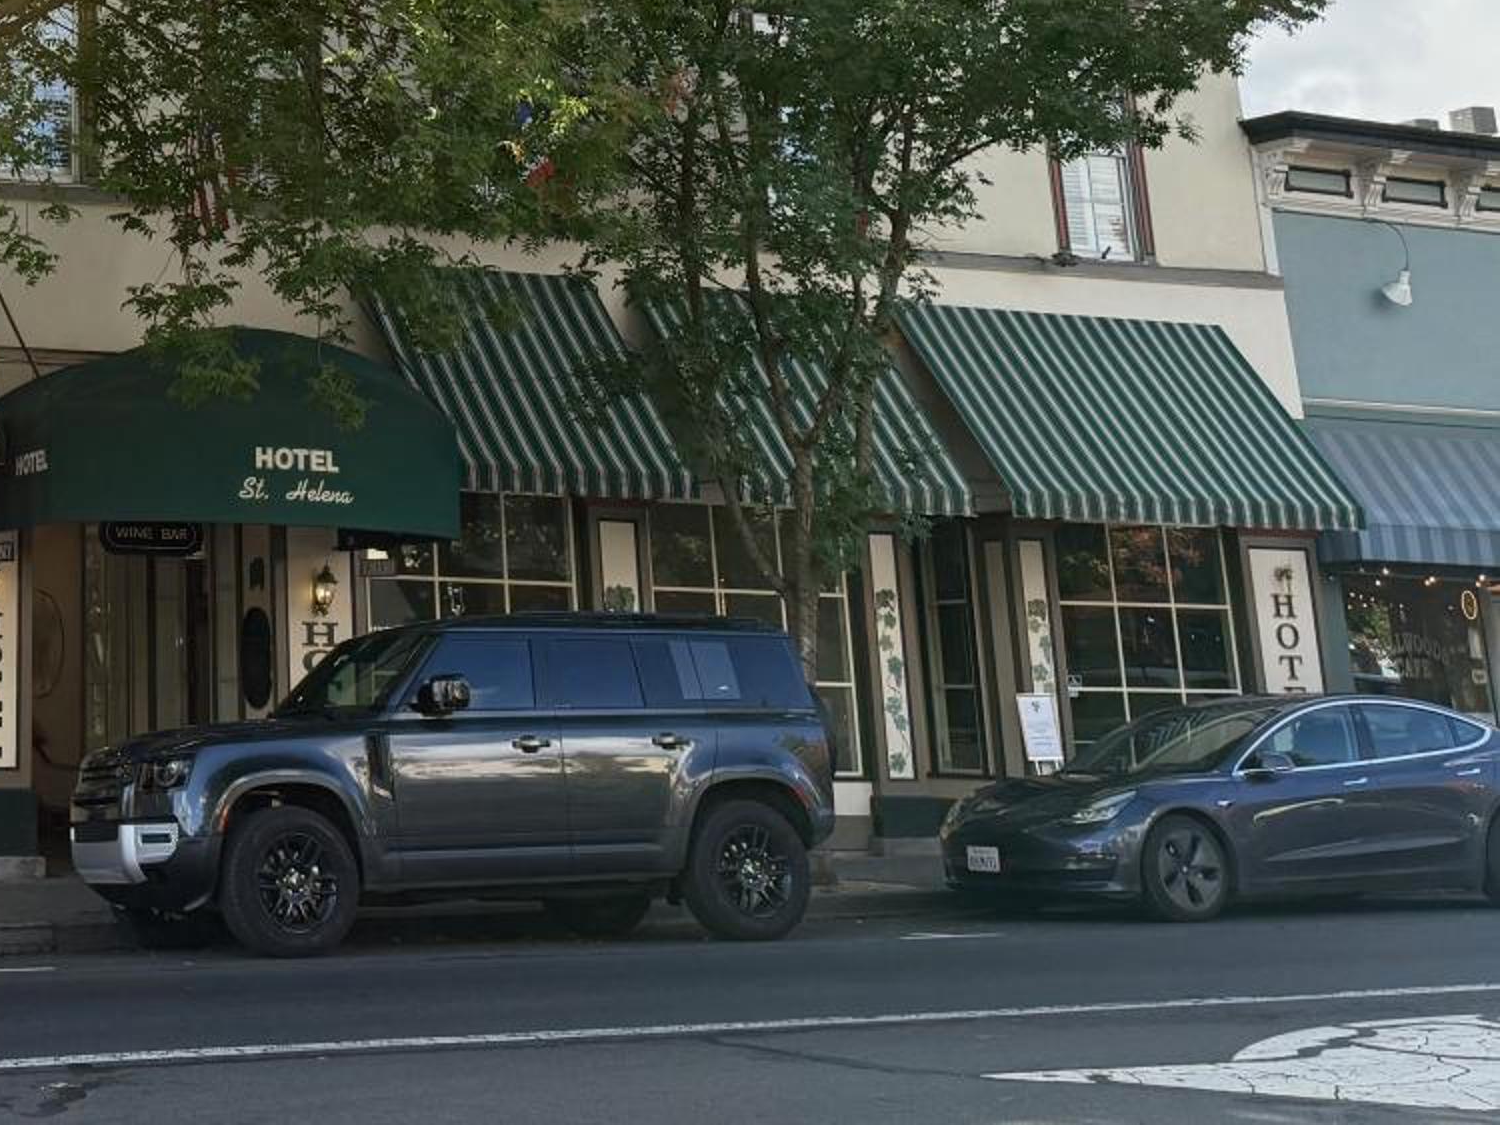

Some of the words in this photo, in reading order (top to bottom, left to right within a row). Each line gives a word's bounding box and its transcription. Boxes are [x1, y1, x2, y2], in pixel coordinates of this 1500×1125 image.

[15, 449, 49, 476] HOTEL
[255, 446, 339, 473] HOTEL
[239, 476, 269, 500] St.
[285, 478, 354, 504] Helena
[115, 526, 153, 539] WINE
[161, 528, 187, 540] BAR
[1270, 592, 1307, 692] HOT
